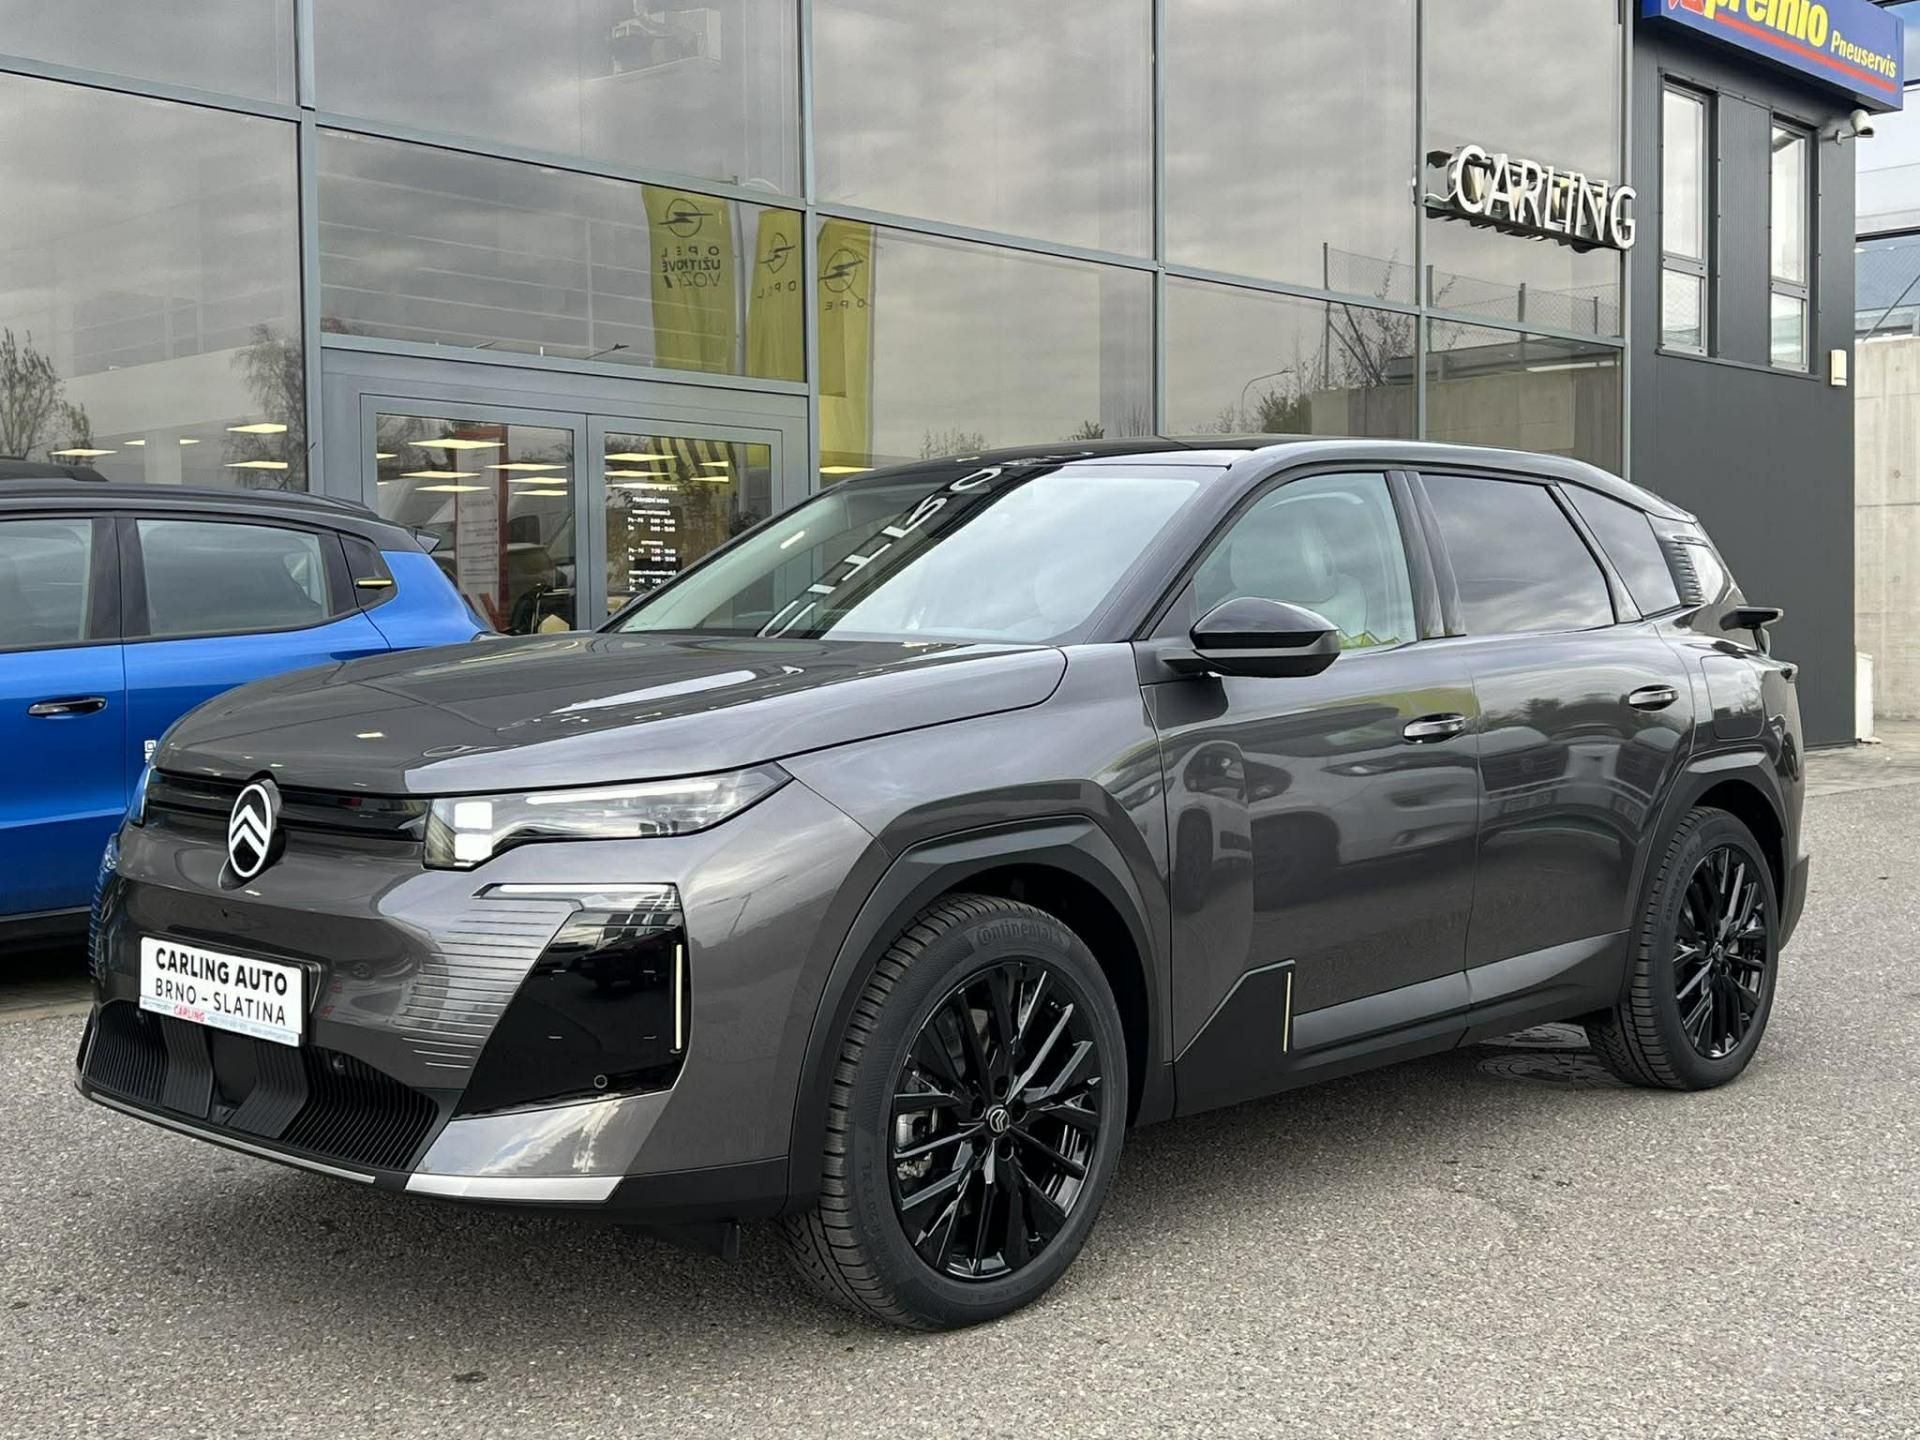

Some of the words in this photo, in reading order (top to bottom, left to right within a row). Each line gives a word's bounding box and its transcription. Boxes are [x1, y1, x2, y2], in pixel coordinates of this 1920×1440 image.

[1830, 30, 1897, 79] Pneuservis
[1455, 144, 1637, 249] CARLING
[156, 947, 230, 985] CARLING
[235, 965, 287, 997] AUTO
[156, 978, 197, 1005] BRNO
[213, 991, 286, 1026] SLATINA
[173, 1003, 205, 1023] CARLING
